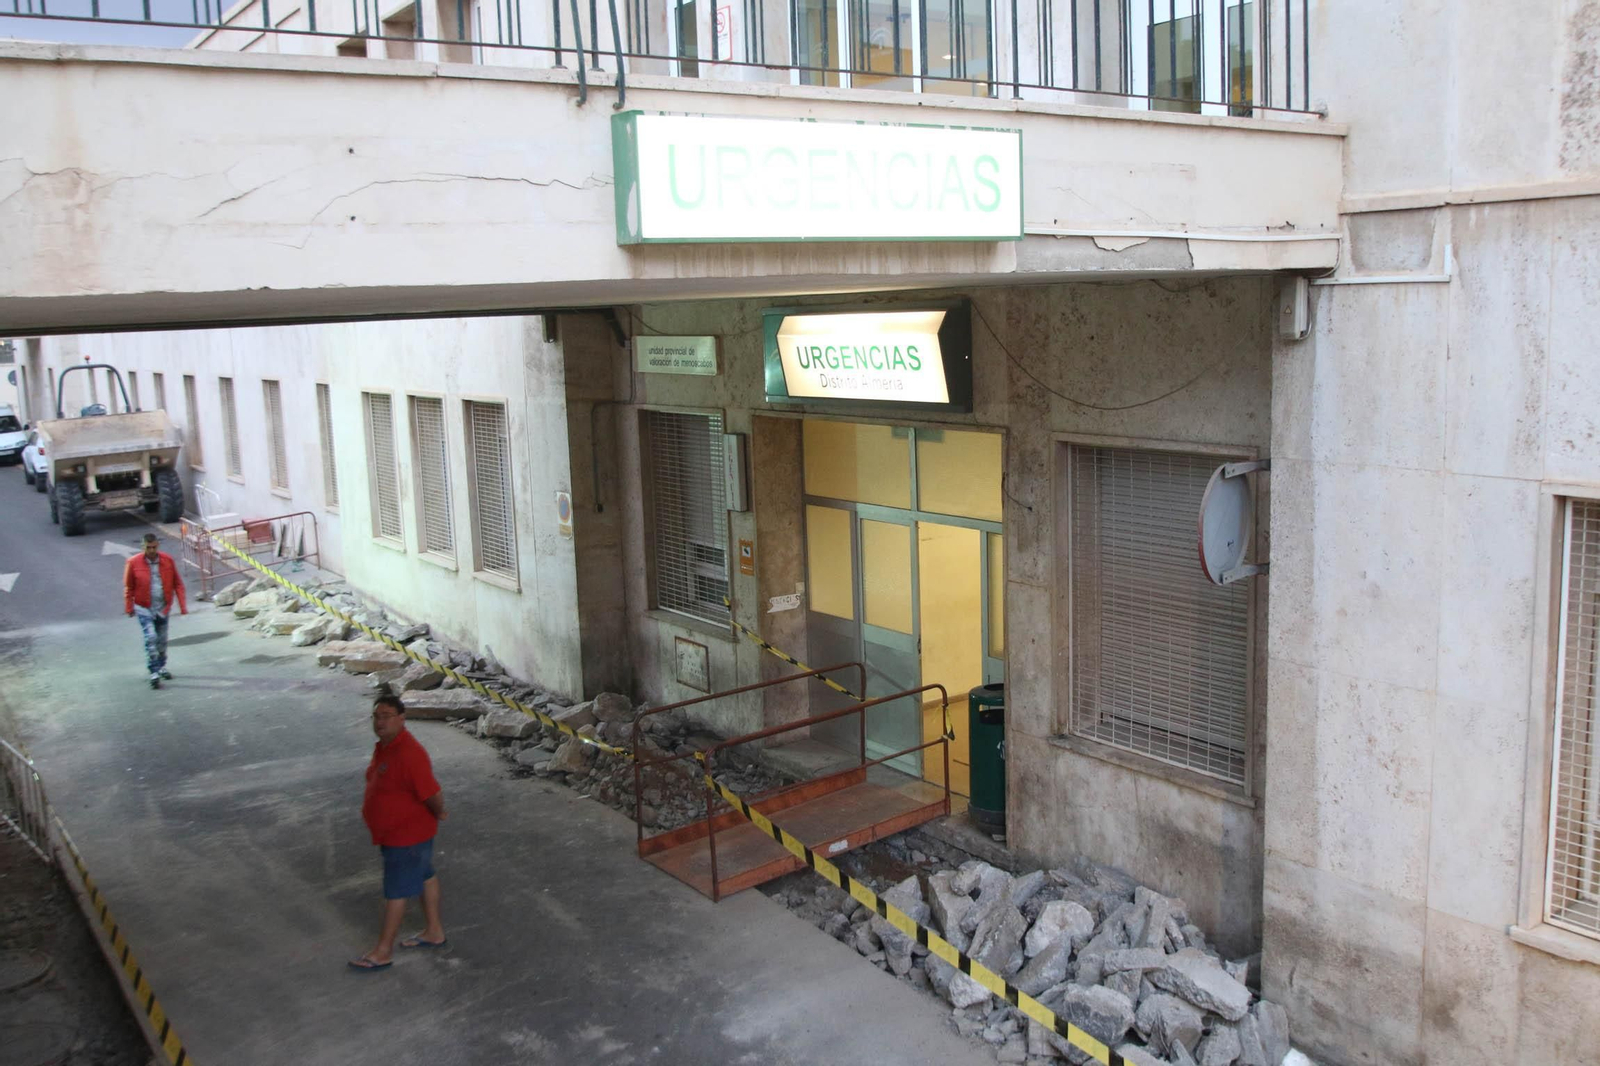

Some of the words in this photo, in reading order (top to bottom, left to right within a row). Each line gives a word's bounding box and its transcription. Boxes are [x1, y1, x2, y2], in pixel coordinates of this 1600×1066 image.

[668, 144, 1002, 212] URGENCIAS
[689, 347, 695, 355] de
[797, 345, 921, 371] URGENCIAS
[673, 359, 679, 367] de
